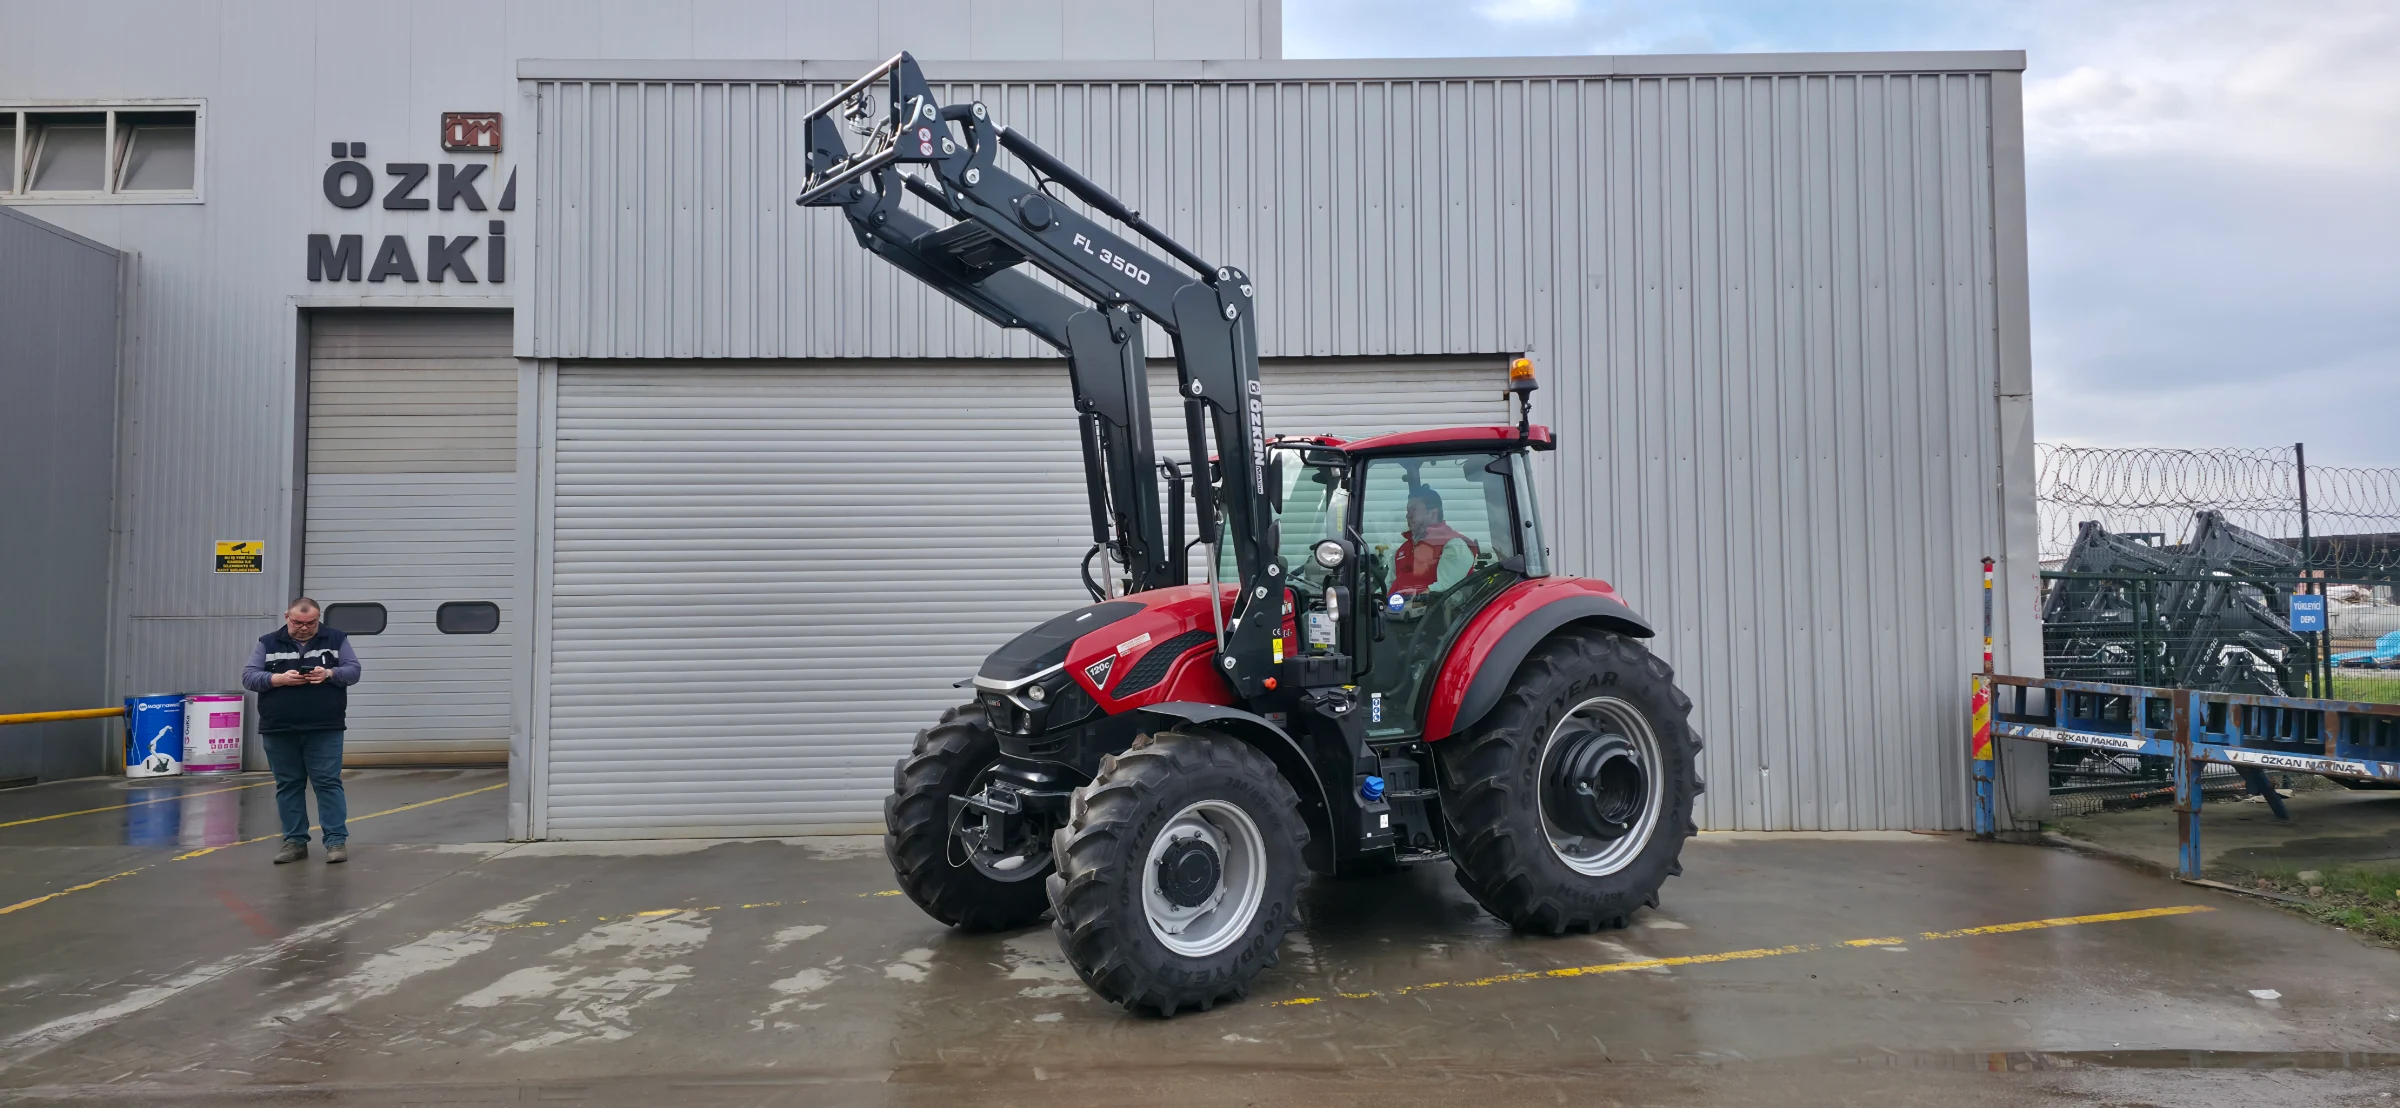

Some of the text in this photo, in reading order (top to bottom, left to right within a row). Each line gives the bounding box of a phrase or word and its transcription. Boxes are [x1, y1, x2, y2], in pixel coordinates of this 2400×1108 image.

[1073, 232, 1151, 286] FL 3500
[1250, 398, 1265, 466] ÖZKAN
[2300, 615, 2316, 624] DEPO
[2056, 732, 2129, 748] ÖZKAN MAKİNA
[2260, 754, 2301, 768] ÖZKAN
